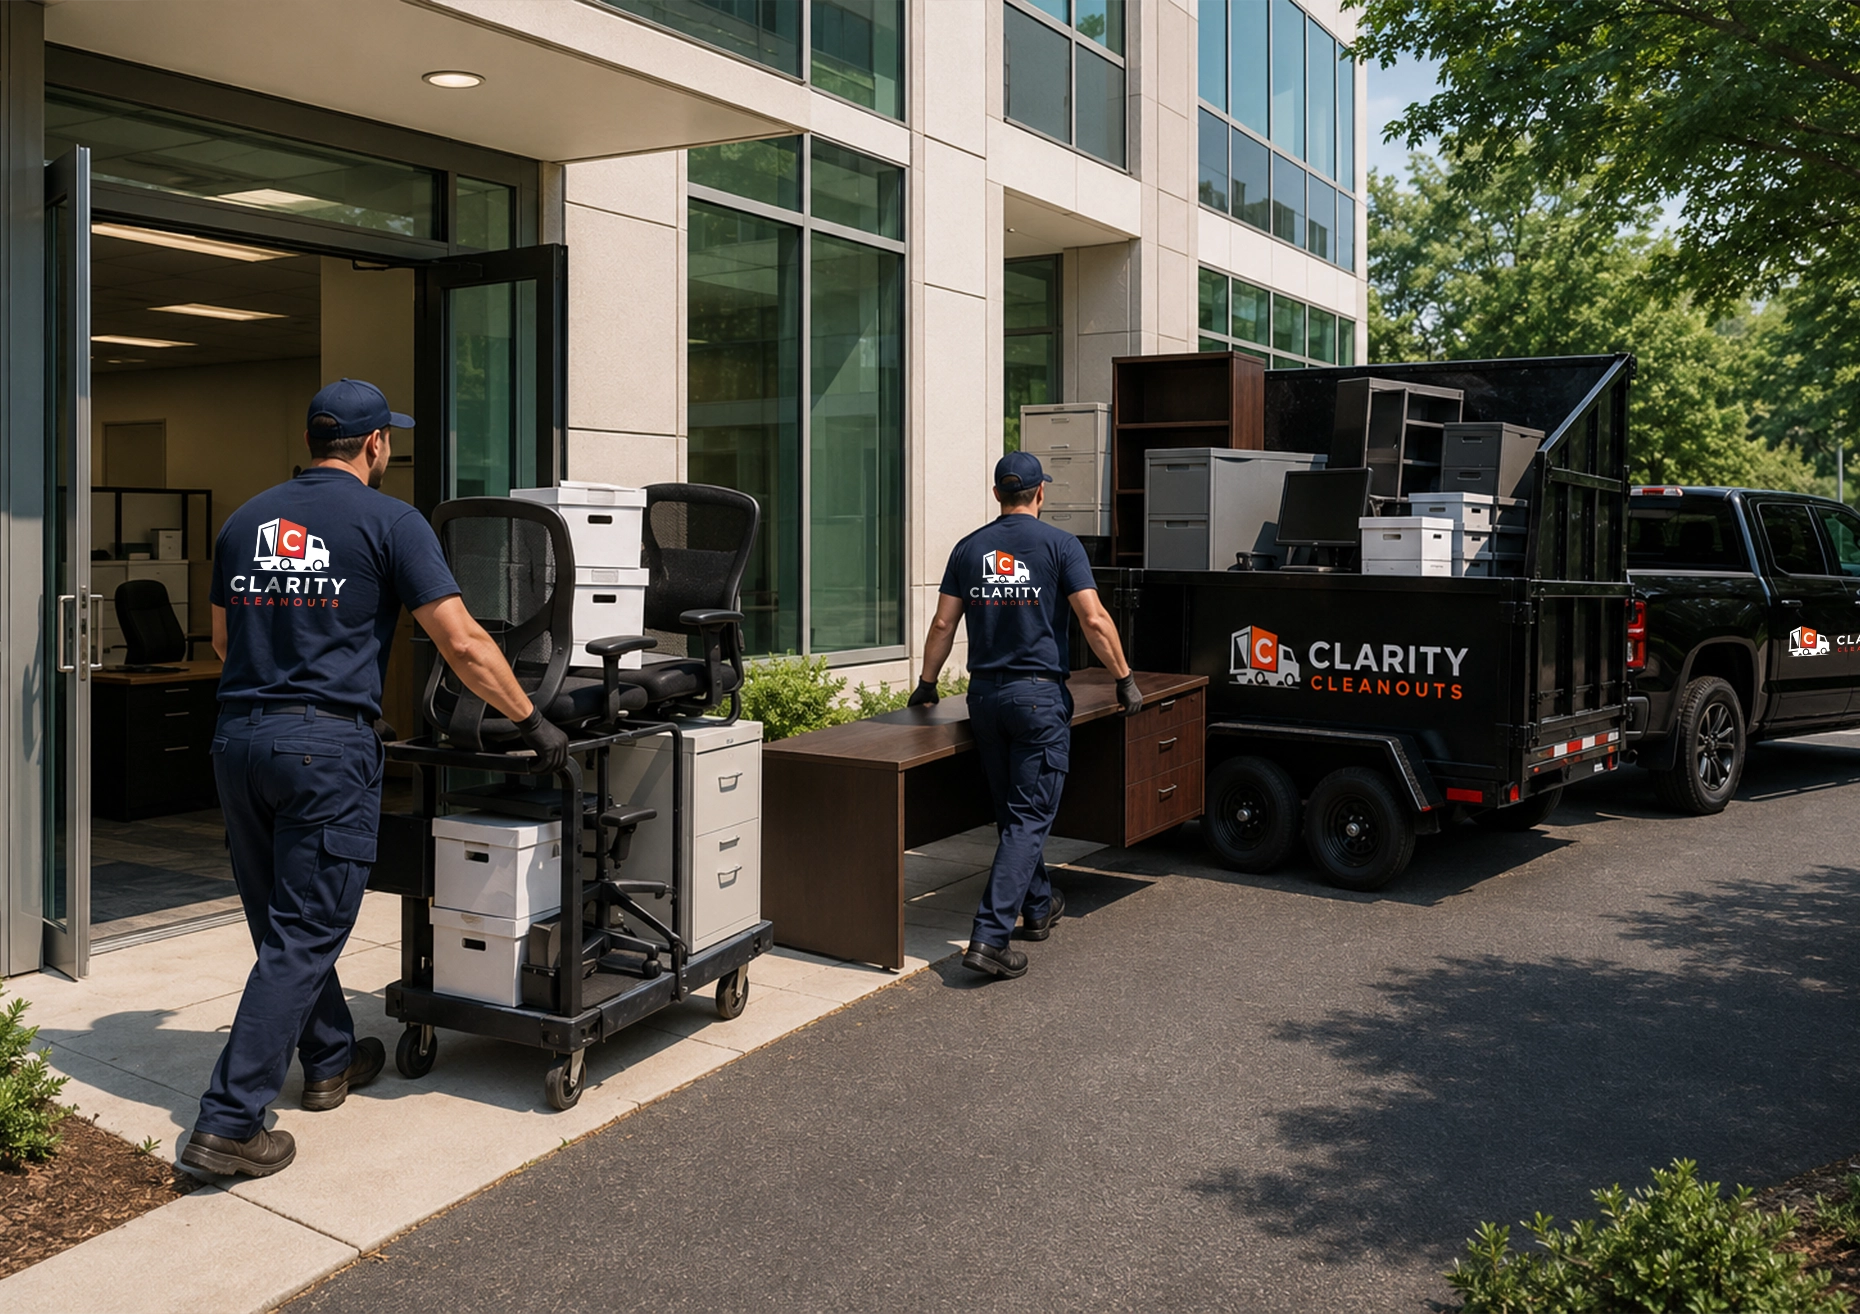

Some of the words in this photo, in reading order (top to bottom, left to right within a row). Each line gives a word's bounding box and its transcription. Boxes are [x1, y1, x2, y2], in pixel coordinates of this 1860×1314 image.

[282, 530, 302, 551] C
[999, 557, 1011, 571] C
[230, 575, 347, 595] CLARITY
[969, 587, 1041, 598] CLARITY
[230, 596, 339, 608] CLEANOUTS
[1803, 632, 1814, 645] C
[1255, 638, 1273, 664] C
[1308, 641, 1469, 676] CLARITY
[1310, 675, 1462, 700] CLEANOUTS
